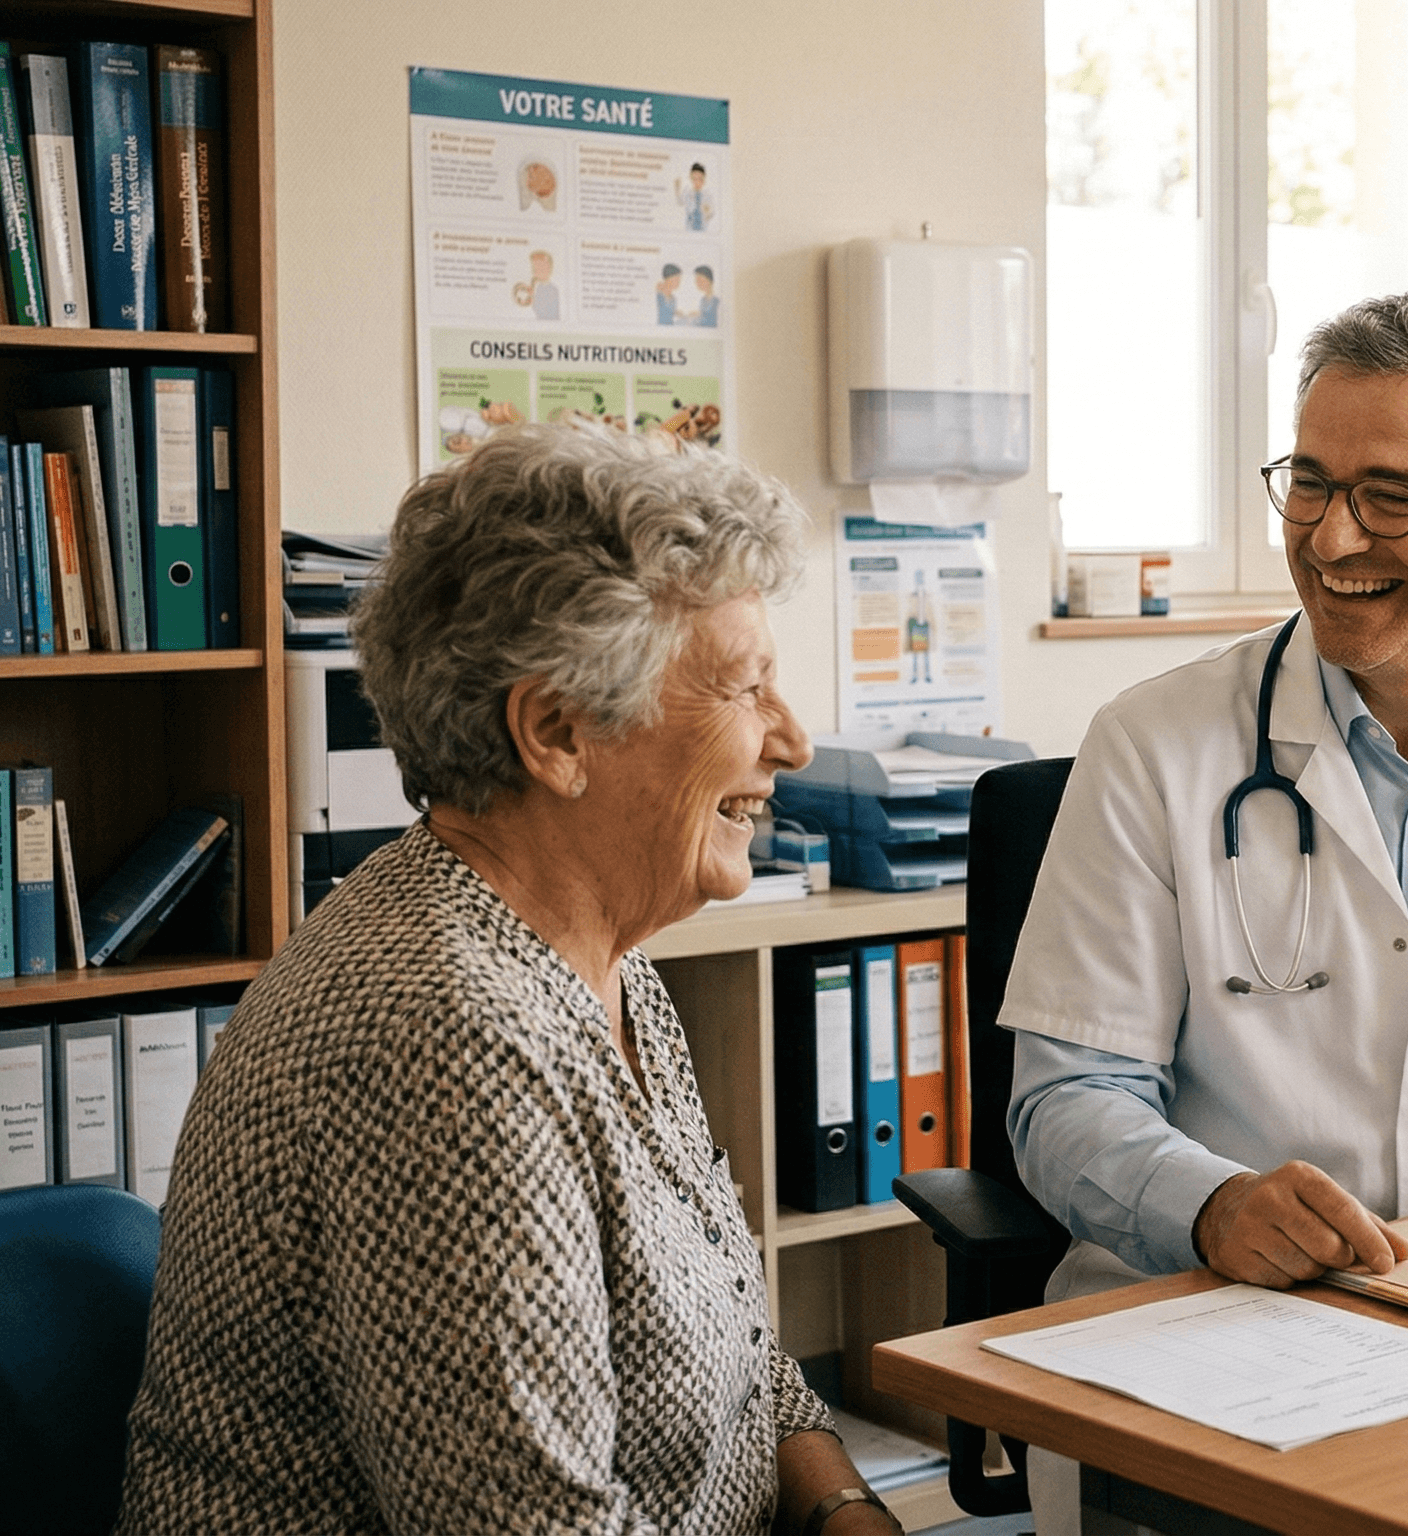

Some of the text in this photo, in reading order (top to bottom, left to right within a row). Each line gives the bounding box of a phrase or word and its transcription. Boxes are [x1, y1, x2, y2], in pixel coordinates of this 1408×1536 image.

[500, 89, 653, 128] VOTRE SANTÉ
[470, 340, 688, 366] CONSEILS NUTRITIONNELS
